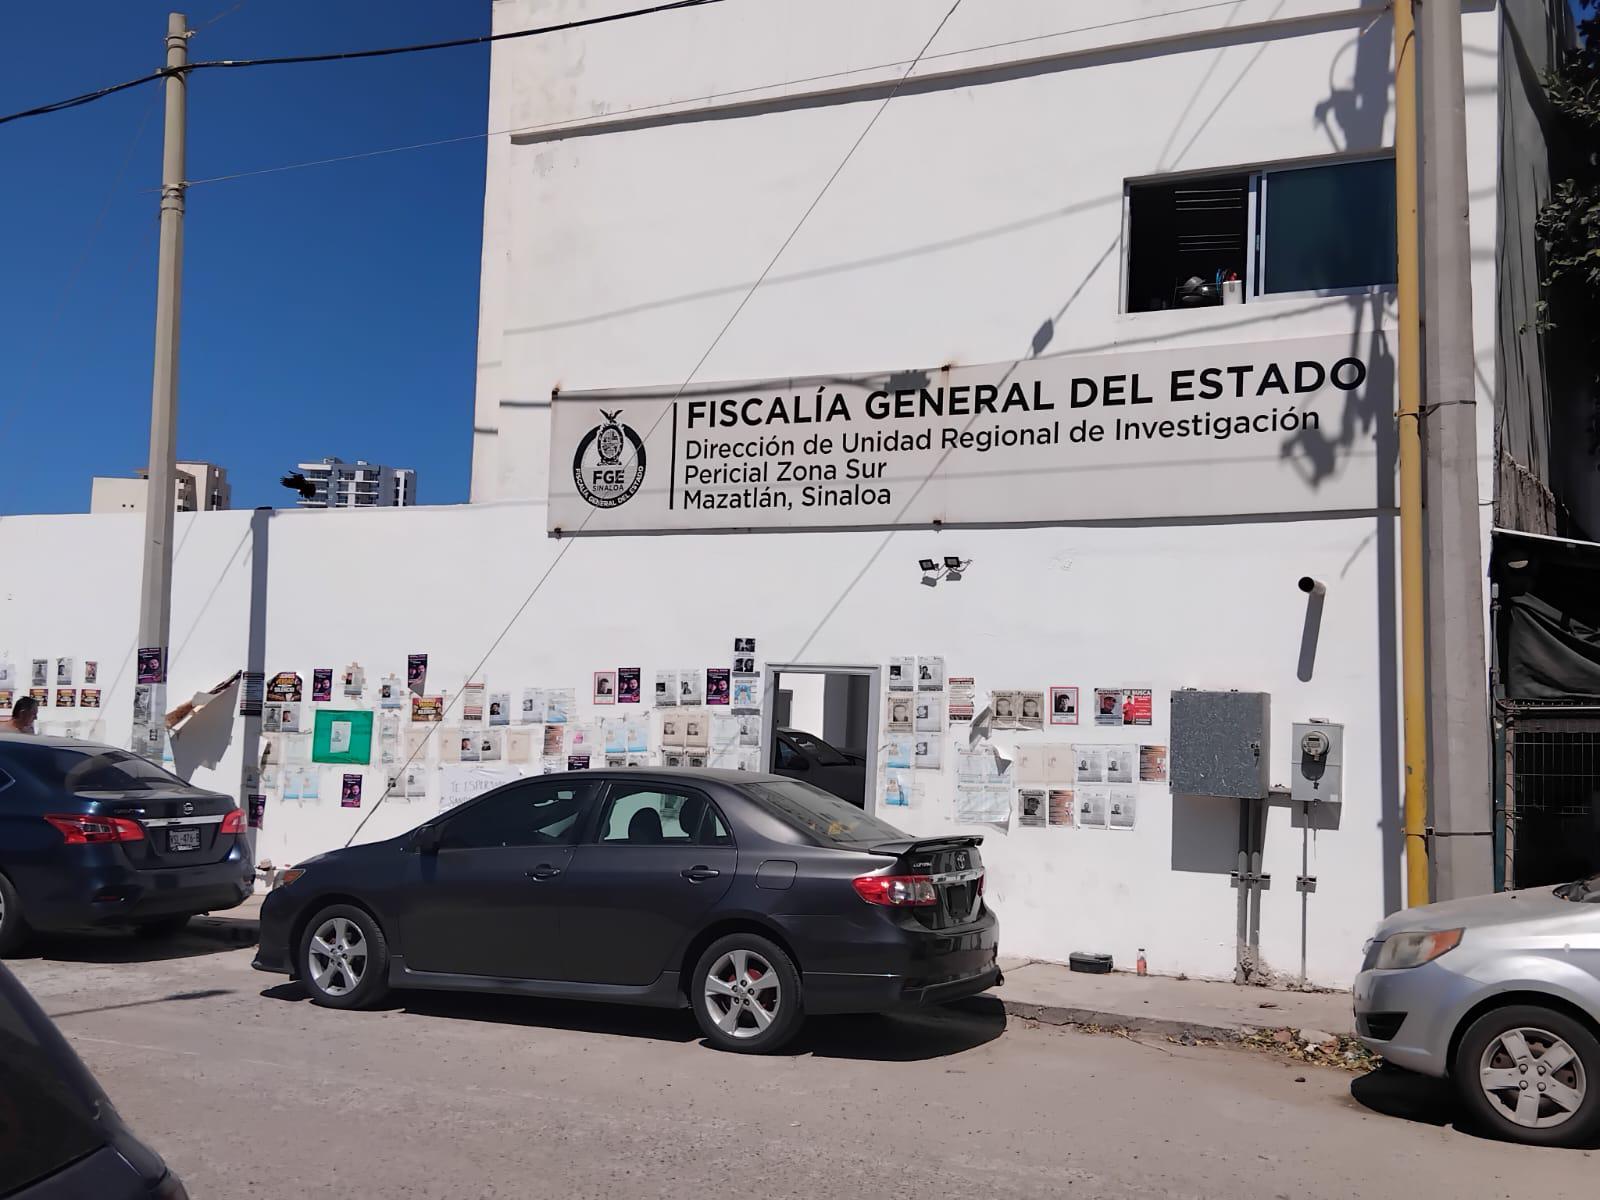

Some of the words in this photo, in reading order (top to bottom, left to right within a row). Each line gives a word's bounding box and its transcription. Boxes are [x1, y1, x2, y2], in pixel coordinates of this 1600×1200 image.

[687, 386, 852, 429] FISCALÍA
[865, 380, 1055, 420] GENERAL
[1070, 374, 1153, 409] DEL
[1170, 357, 1367, 402] ESTADO
[686, 435, 795, 460] Dirección
[803, 433, 833, 455] de
[842, 428, 932, 454] Unidad
[941, 421, 1059, 452] Regional
[1069, 419, 1105, 443] de
[1116, 406, 1320, 440] Investigación
[593, 469, 625, 484] FGE
[685, 461, 768, 485] Pericial
[776, 461, 837, 482] Zona
[845, 458, 888, 480] Sur
[592, 484, 625, 492] SINALOA
[683, 486, 793, 511] Mazatlán,
[801, 483, 892, 507] Sinaloa
